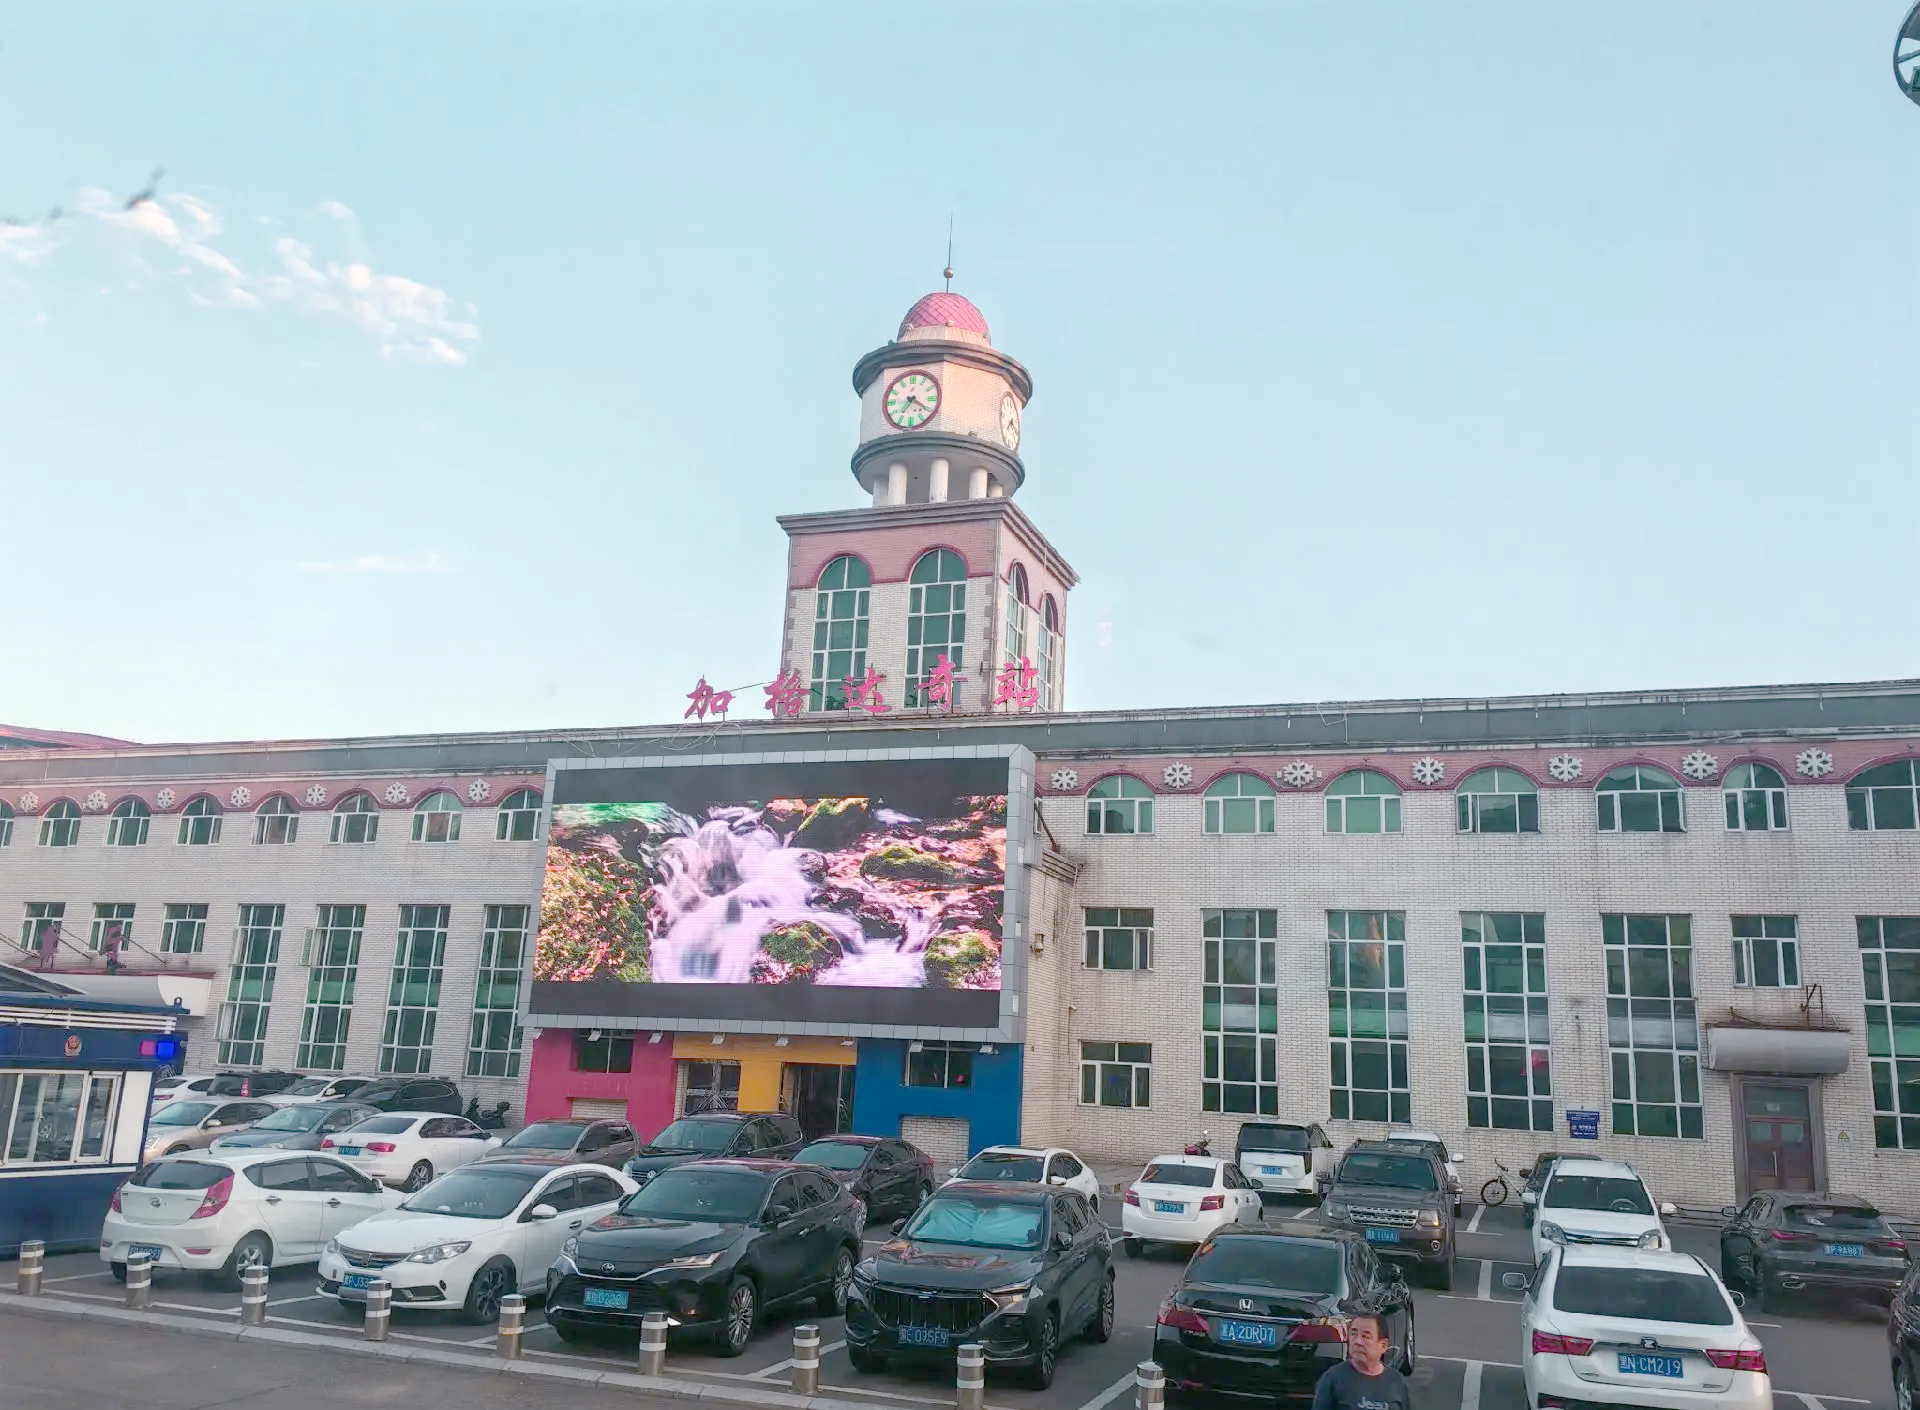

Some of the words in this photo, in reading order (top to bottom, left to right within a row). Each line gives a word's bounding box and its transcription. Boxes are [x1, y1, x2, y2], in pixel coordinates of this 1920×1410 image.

[684, 653, 1039, 720] 加格达奇站
